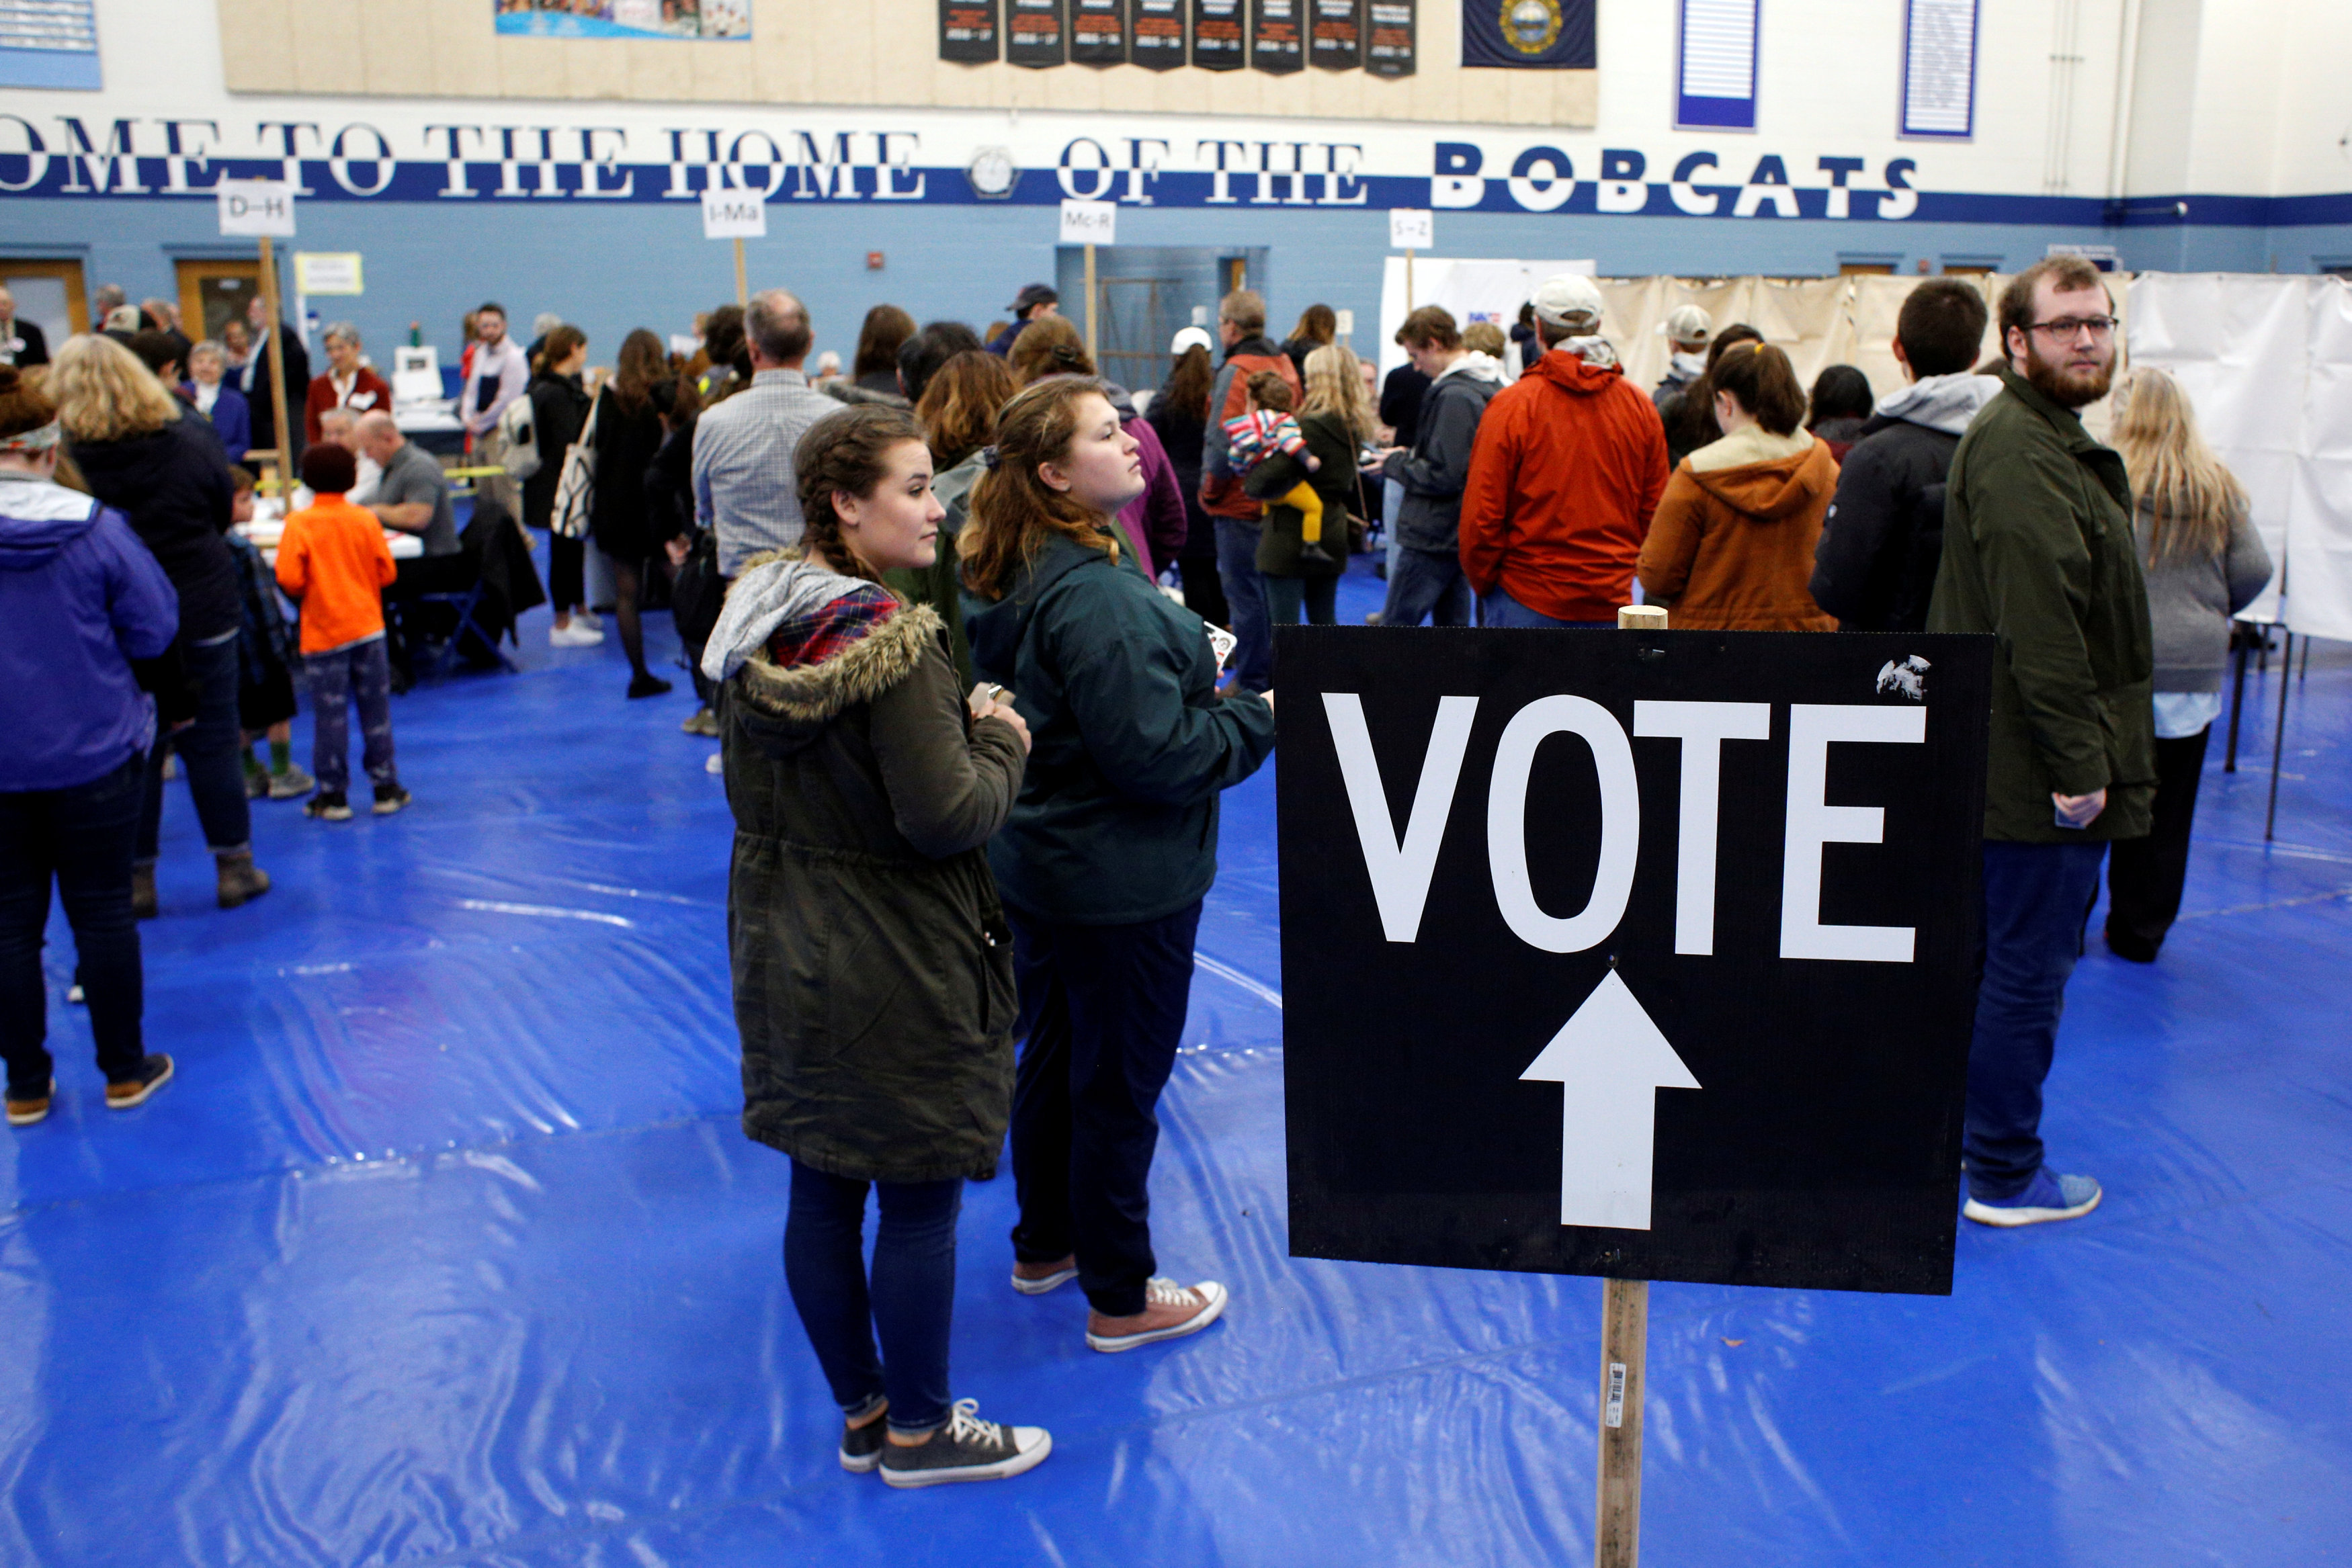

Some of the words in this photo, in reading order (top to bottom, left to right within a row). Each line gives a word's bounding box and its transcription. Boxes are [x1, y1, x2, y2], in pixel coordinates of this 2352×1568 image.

[257, 122, 396, 196] TO
[424, 126, 634, 198] THE
[661, 130, 925, 199] HOME
[1056, 137, 1169, 204] OF
[1196, 140, 1368, 205] THE
[1431, 142, 1919, 220] BOBCATS
[1321, 693, 1927, 962] VOTE
